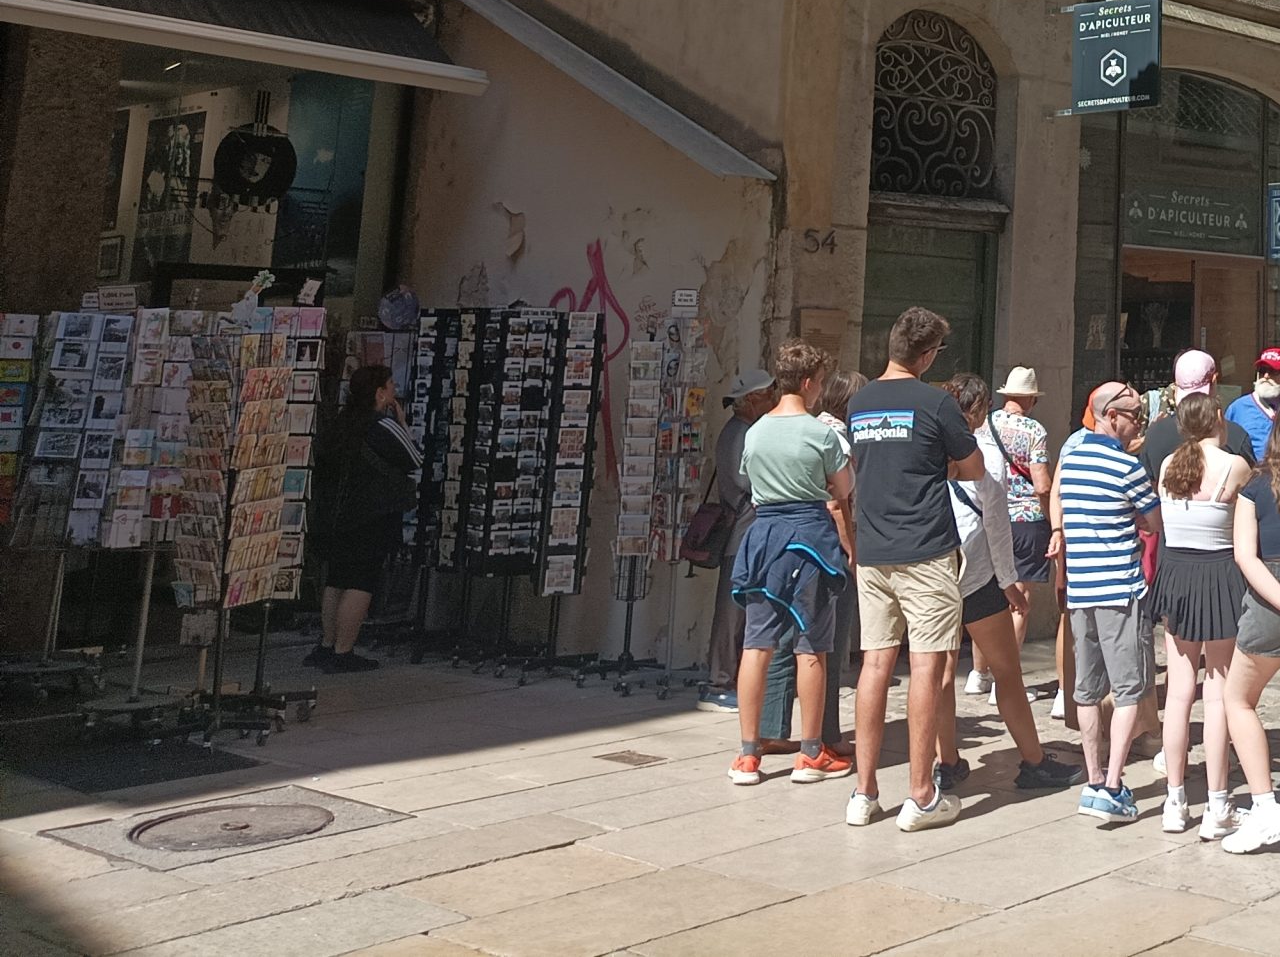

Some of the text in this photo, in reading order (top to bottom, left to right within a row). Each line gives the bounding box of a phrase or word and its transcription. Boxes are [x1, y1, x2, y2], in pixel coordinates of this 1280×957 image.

[1098, 4, 1132, 16] Secrets
[1079, 13, 1151, 32] D'APICULTEUR
[1077, 94, 1150, 108] SECRETSDAPICULTEUR.COM
[1171, 190, 1211, 207] Secrets
[1147, 206, 1232, 228] D'APICULTEUR
[804, 228, 838, 255] 54
[853, 426, 908, 444] patagonia
